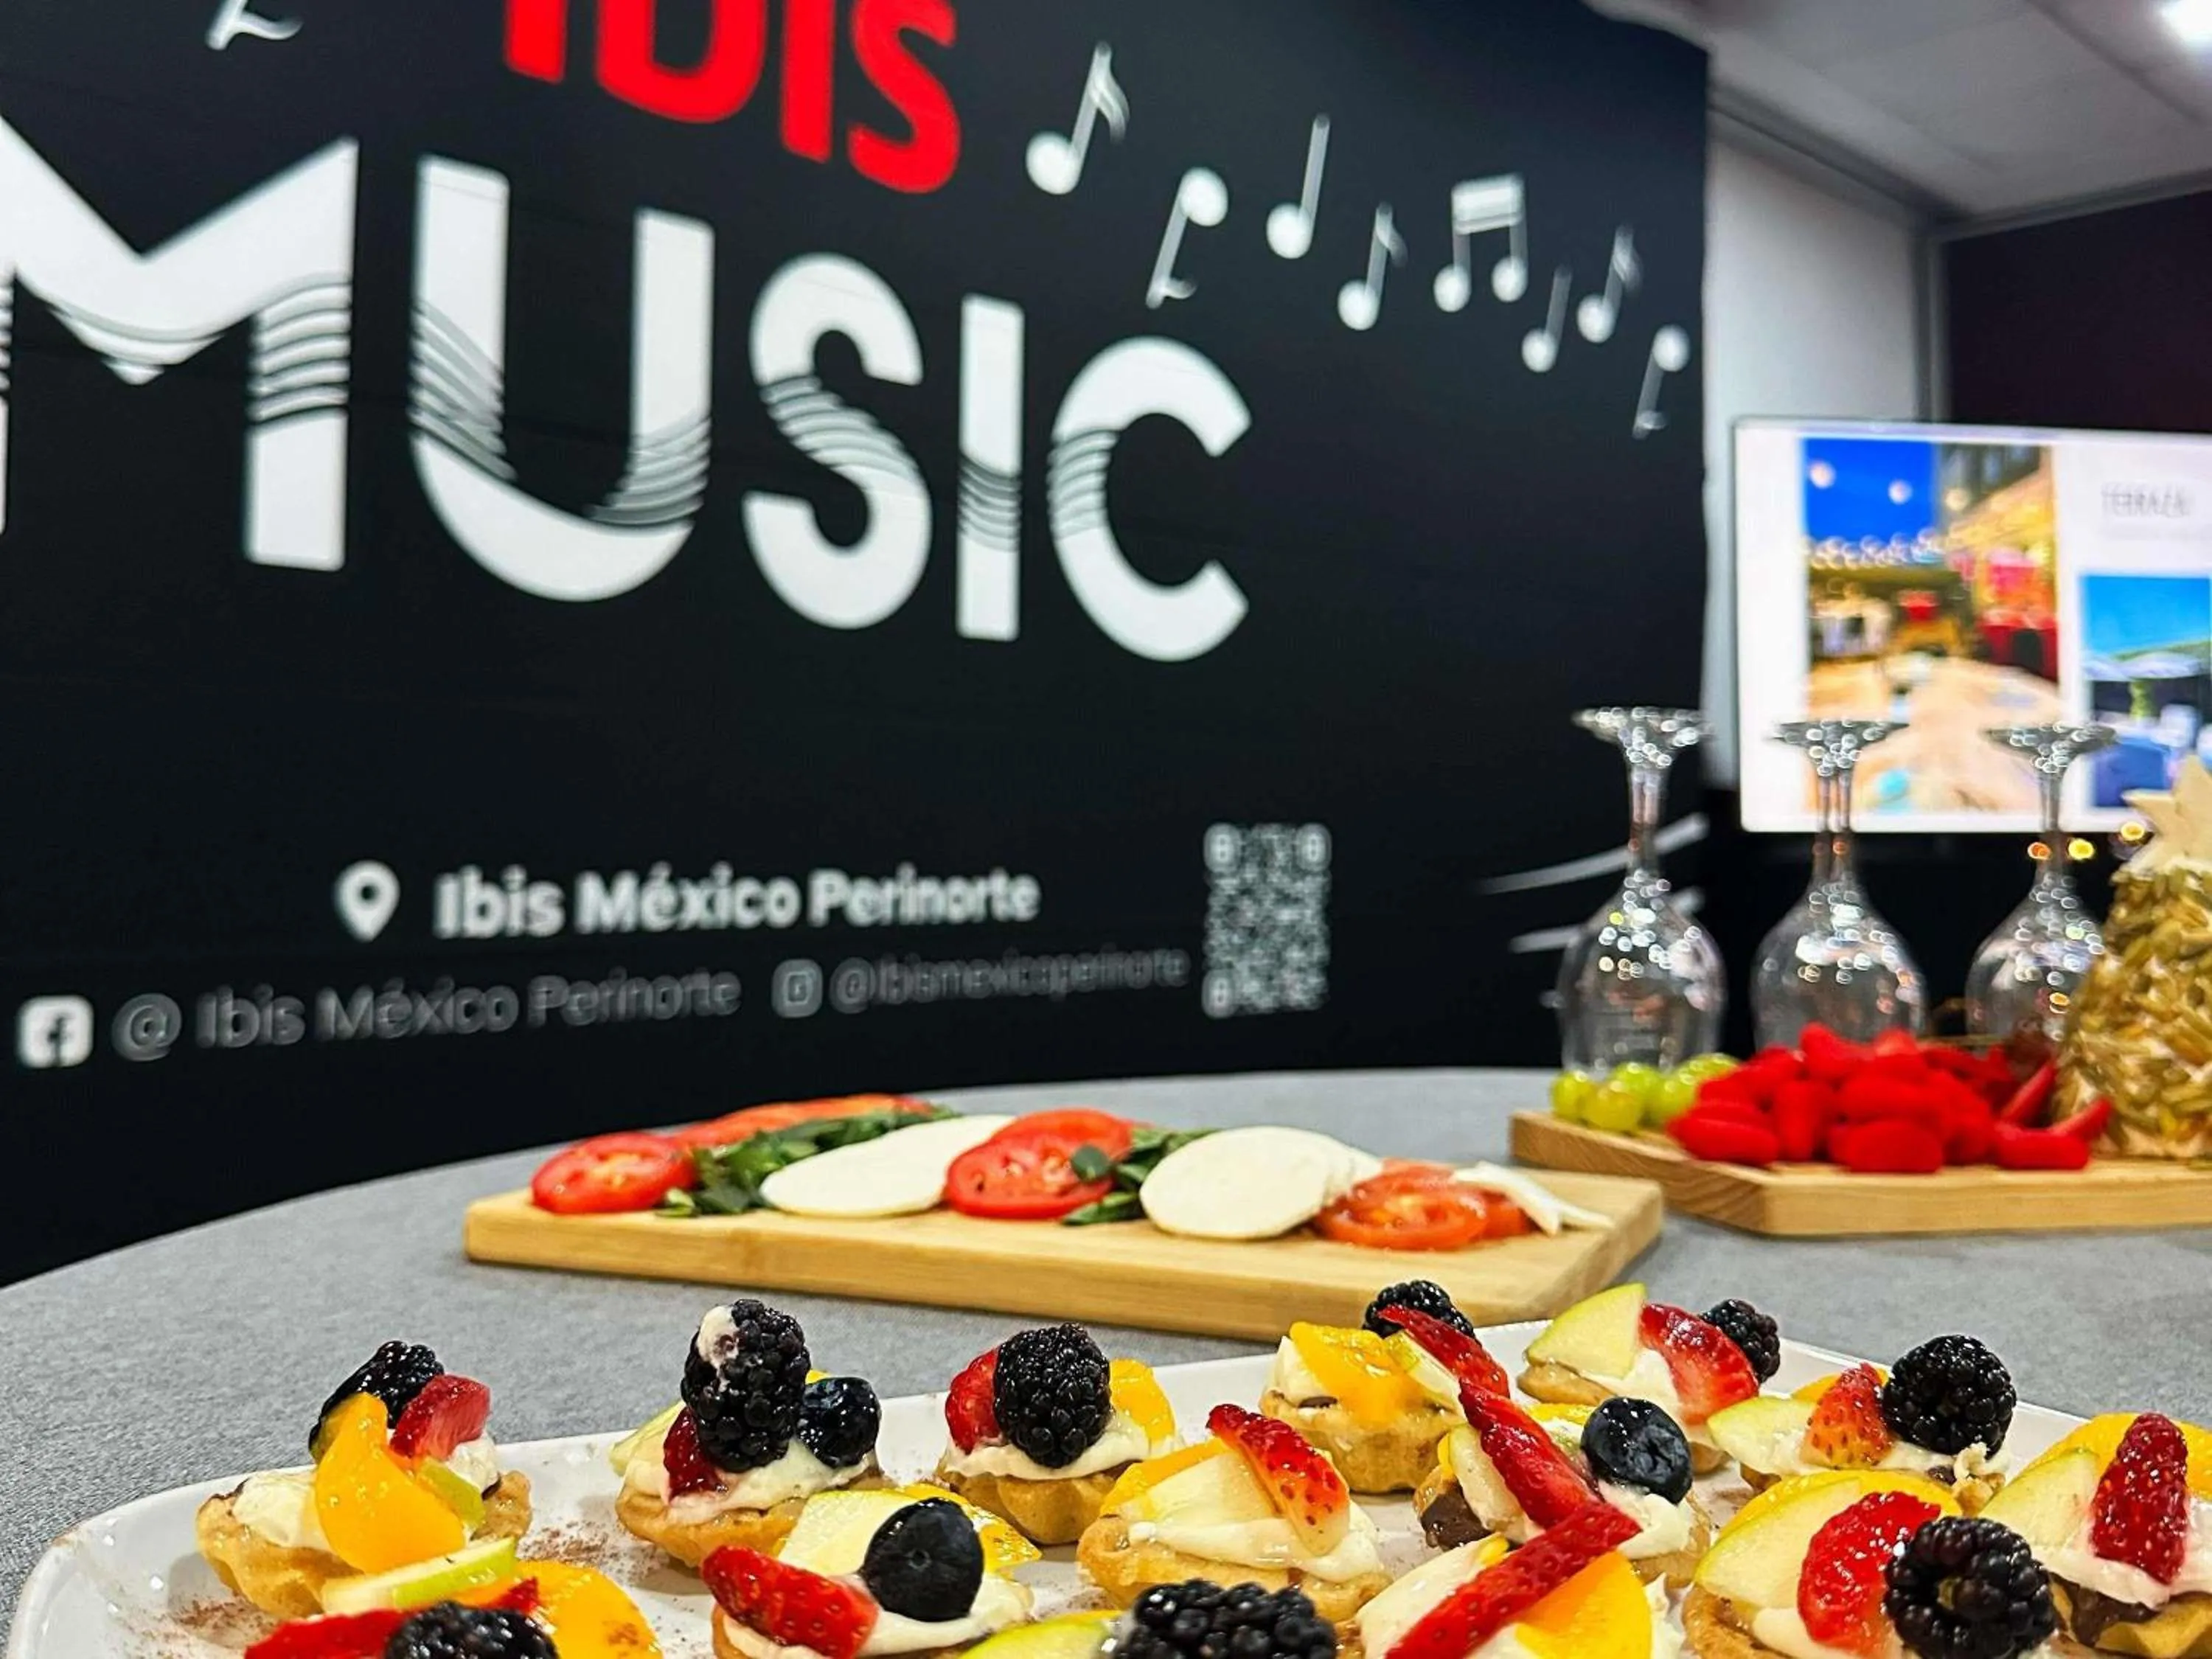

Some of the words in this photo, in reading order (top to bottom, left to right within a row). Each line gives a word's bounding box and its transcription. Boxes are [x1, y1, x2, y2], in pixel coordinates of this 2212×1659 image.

[0, 114, 1252, 662] MUSIC
[434, 864, 566, 939] Ibis
[574, 861, 802, 934] México
[807, 862, 1041, 928] Perinorte
[196, 983, 306, 1048] Ibis
[314, 975, 520, 1040] México
[526, 965, 742, 1028] Perinorte
